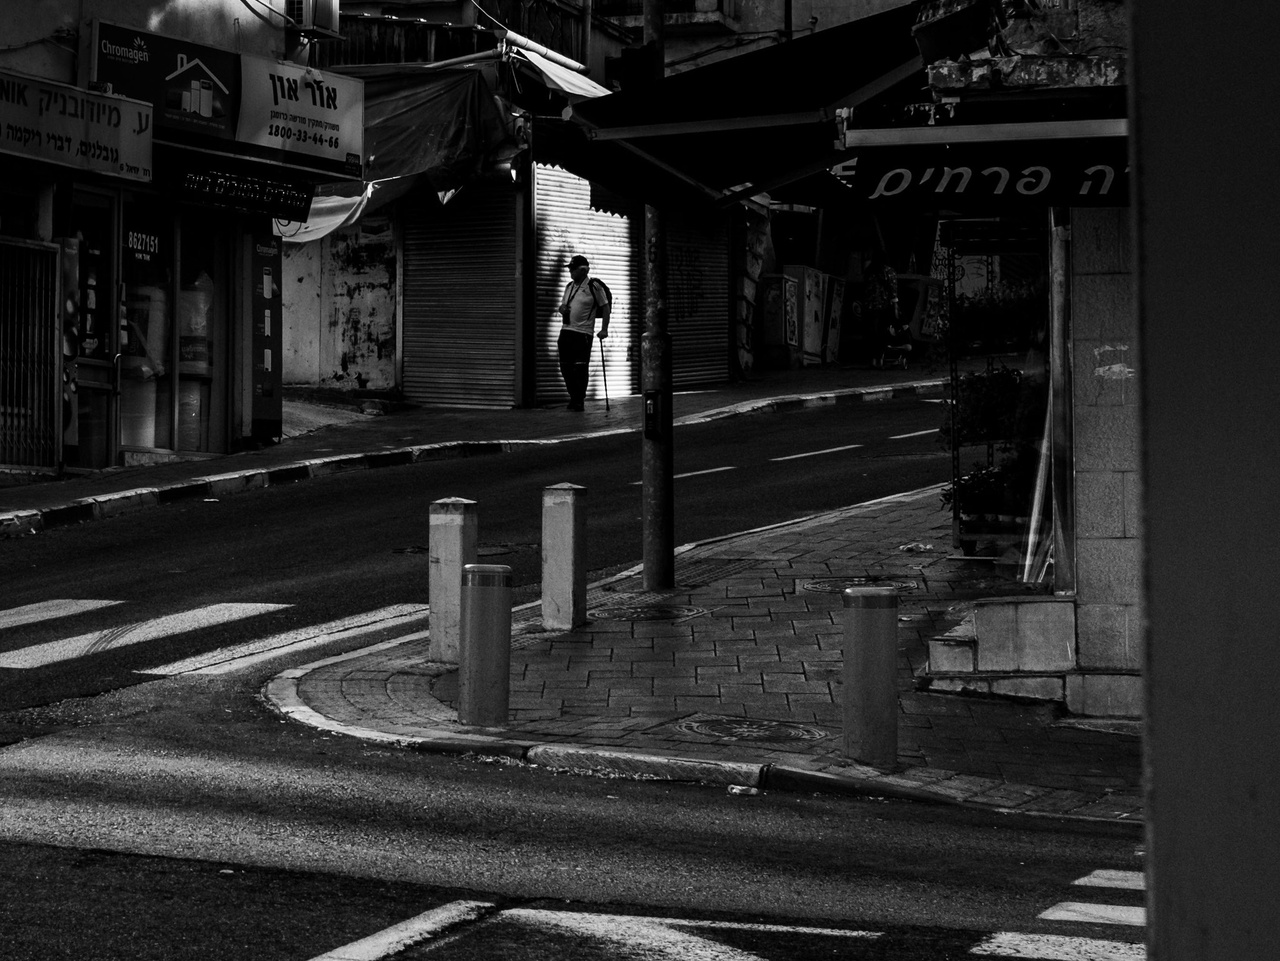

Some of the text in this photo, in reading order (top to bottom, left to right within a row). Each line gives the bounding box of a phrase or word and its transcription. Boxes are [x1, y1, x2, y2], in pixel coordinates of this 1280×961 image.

[101, 40, 149, 64] Chromagen
[269, 73, 338, 110] אור און
[38, 89, 122, 128] מיודובניק
[6, 123, 42, 147] ריקמה
[46, 132, 72, 153] דברי
[268, 124, 339, 149] 1800-33-44-66
[868, 166, 1051, 199] פרחים
[128, 230, 158, 254] 8627151
